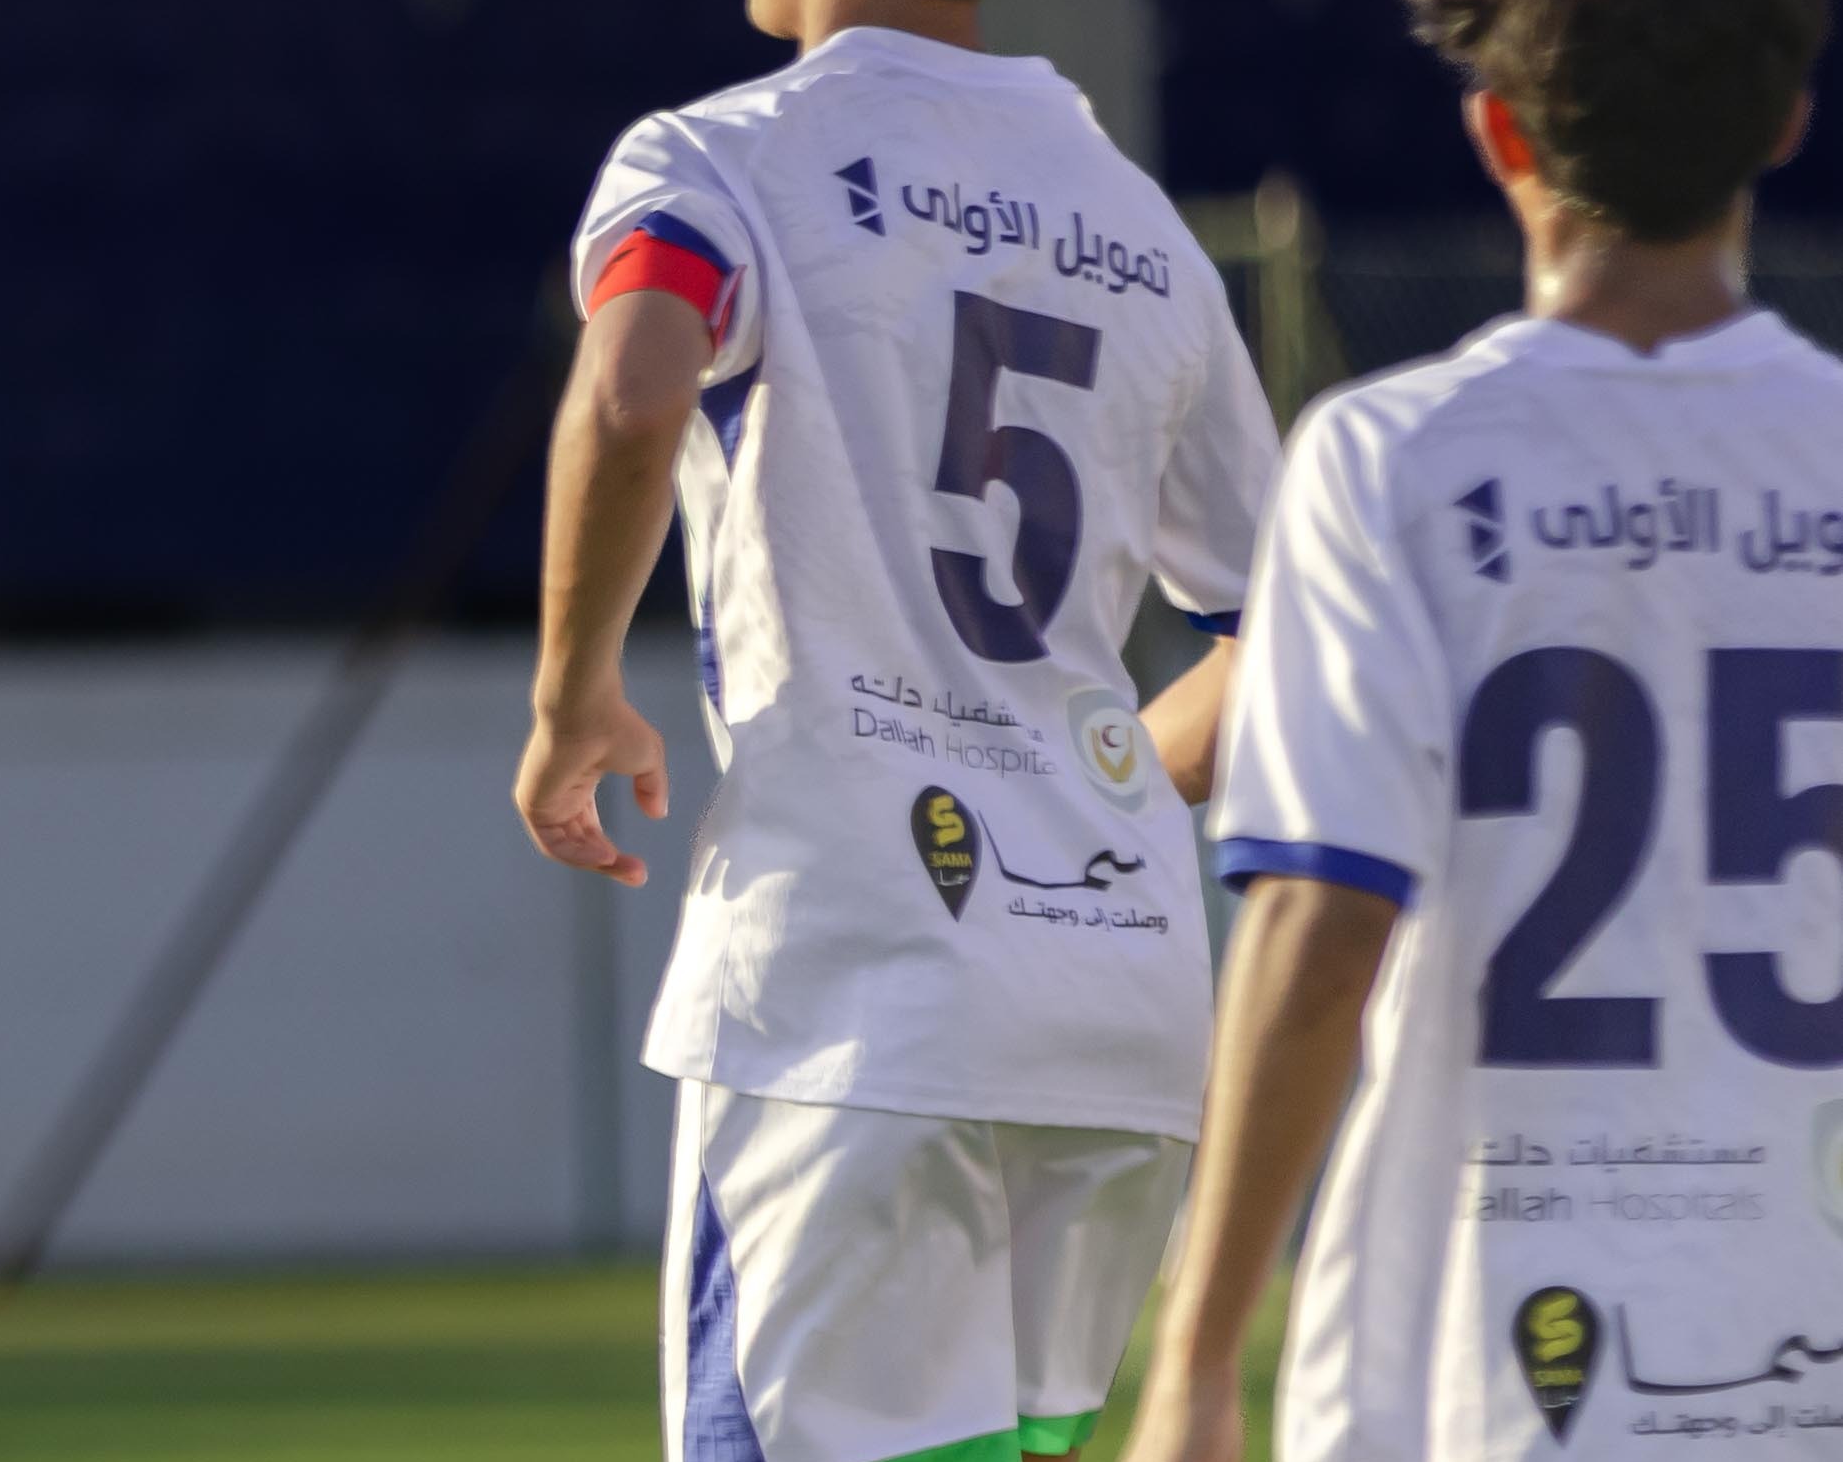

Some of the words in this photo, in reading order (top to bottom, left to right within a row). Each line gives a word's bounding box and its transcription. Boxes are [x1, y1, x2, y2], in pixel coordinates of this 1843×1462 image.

[902, 183, 1041, 255] الأولى
[1054, 212, 1170, 298] تمويل
[930, 289, 1103, 664] 5
[1529, 477, 1721, 572] الأولى
[853, 707, 936, 758] Dallah
[1459, 644, 1843, 1072] 25
